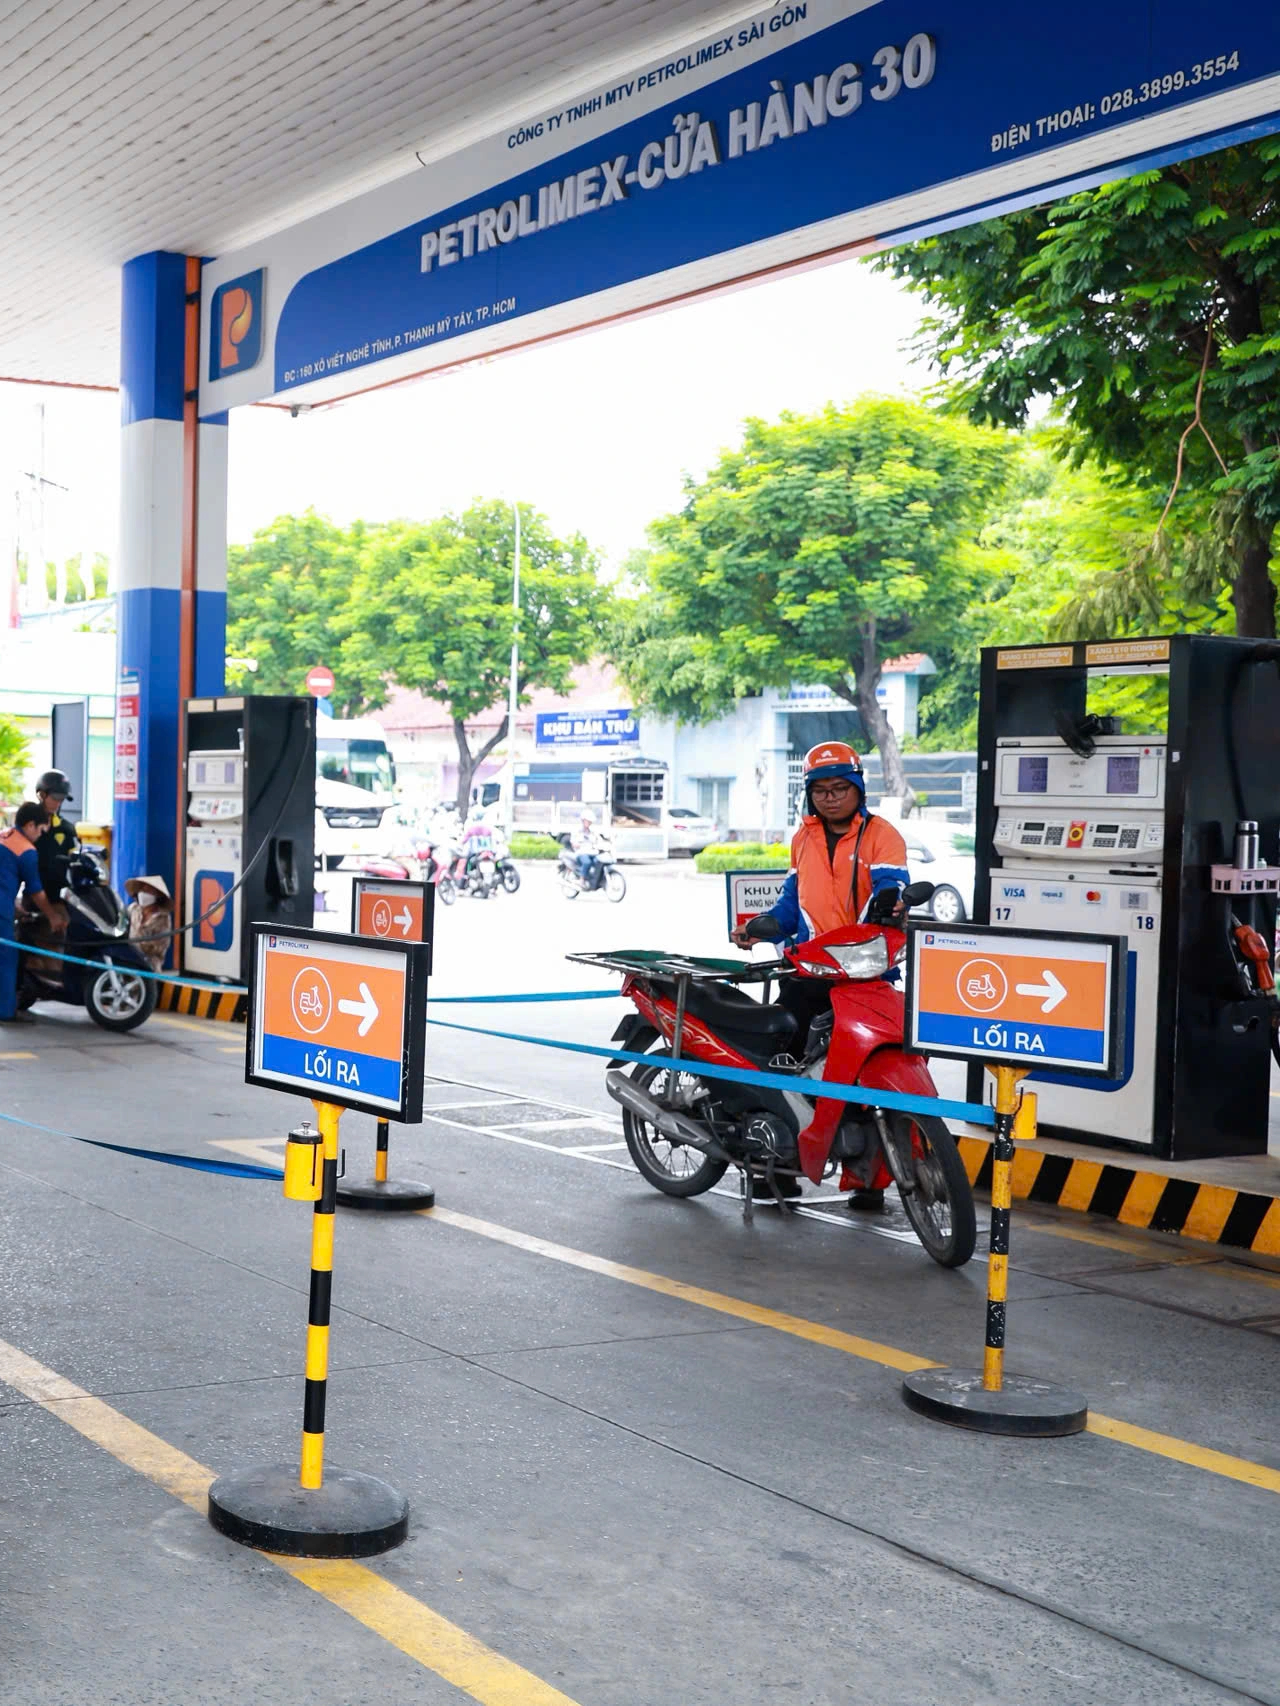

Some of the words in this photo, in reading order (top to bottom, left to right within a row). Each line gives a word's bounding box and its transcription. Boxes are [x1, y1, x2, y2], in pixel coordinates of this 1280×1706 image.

[507, 122, 544, 149] CÔNG
[546, 113, 564, 132] TY
[566, 96, 602, 123] TNHH
[605, 81, 635, 107] MTV
[637, 36, 734, 92] PETROLIMEX
[737, 22, 765, 47] SÀI
[769, 3, 808, 33] GÒN
[728, 62, 863, 158] HÀNG
[870, 32, 938, 102] 30
[991, 123, 1031, 152] ĐIỆN
[1035, 102, 1096, 137] THOẠI:
[1100, 50, 1240, 115] 028.3899.3554
[404, 324, 435, 344] THẠNH
[476, 306, 491, 321] TP.
[492, 296, 516, 316] HCM
[543, 721, 571, 736] KHU
[744, 887, 771, 895] KHU
[1004, 887, 1026, 898] VISA
[744, 899, 763, 908] ĐANG
[995, 907, 1011, 921] 17
[1137, 916, 1154, 930] 18
[279, 940, 309, 950] PETROLIMEX
[938, 938, 976, 946] PETROLIMEX
[973, 1024, 1008, 1047] LỐI
[1014, 1031, 1046, 1052] RA
[304, 1049, 331, 1079] LỐI
[336, 1060, 361, 1086] RA
